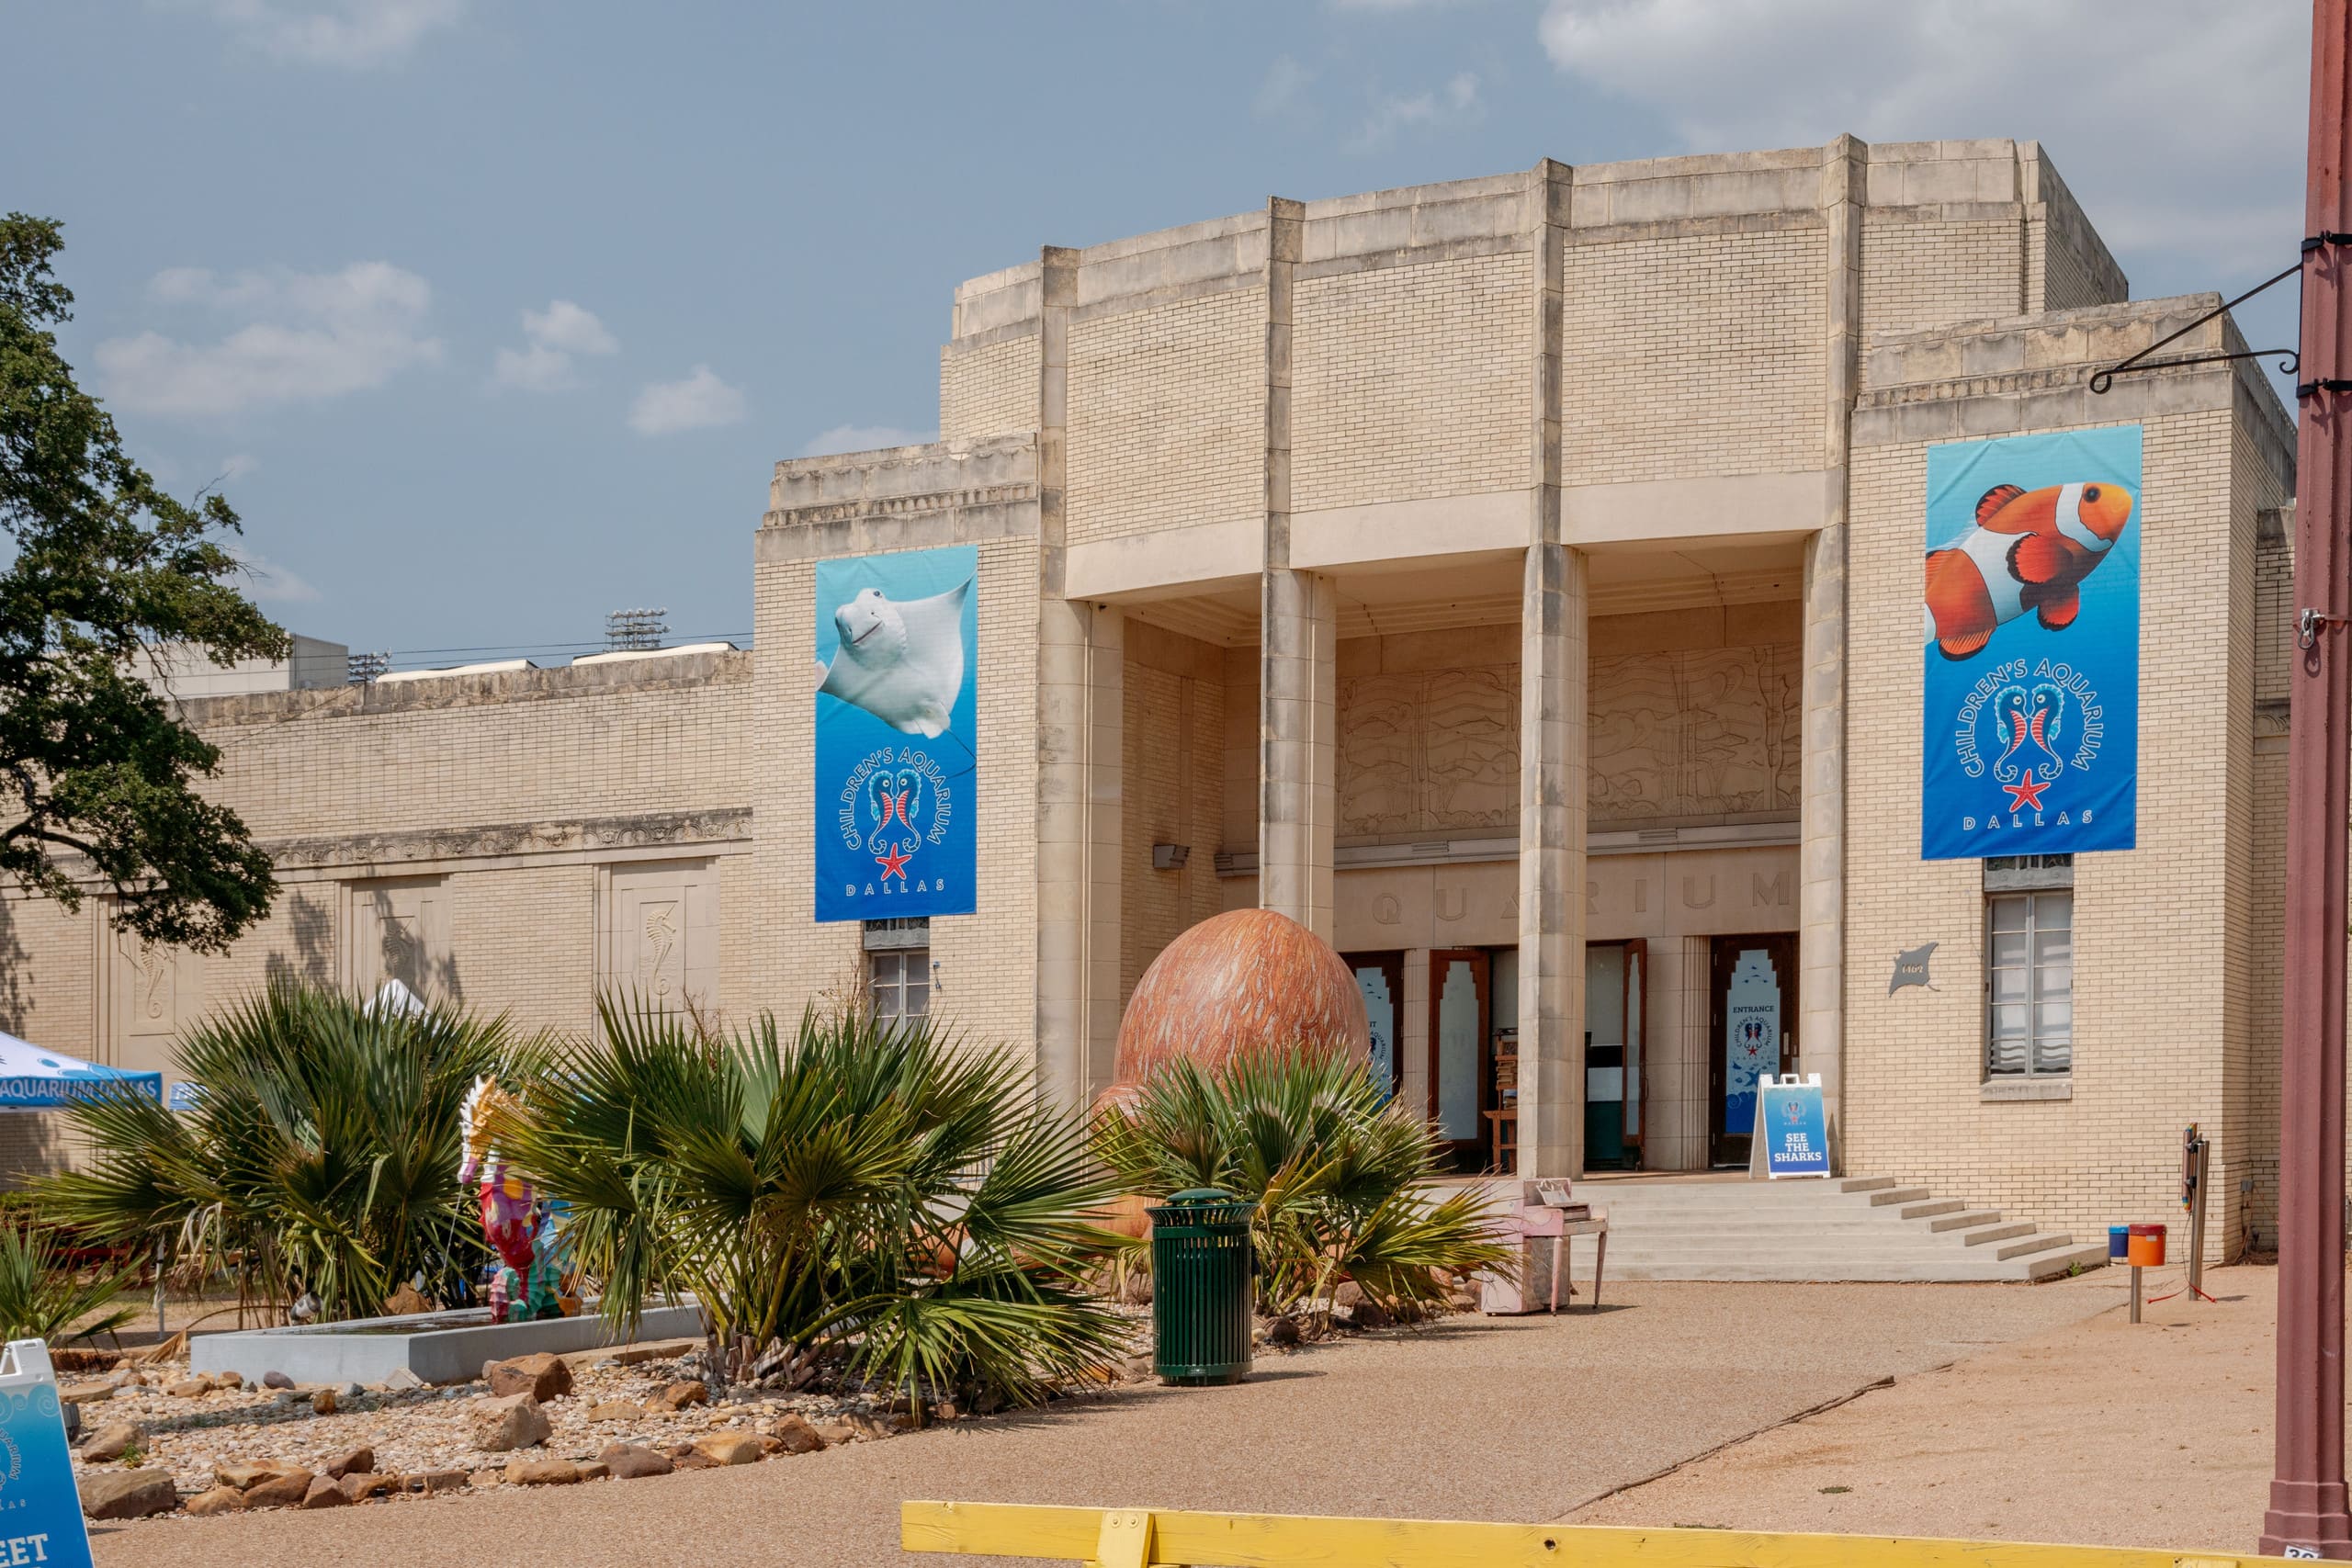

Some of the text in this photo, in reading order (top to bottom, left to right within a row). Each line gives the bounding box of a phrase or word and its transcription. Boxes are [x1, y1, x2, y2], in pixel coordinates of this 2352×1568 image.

[1956, 658, 2104, 778] CHILDREN'S AQUARIUM
[839, 746, 952, 851] CHILDREN'S AQUARIUM
[1963, 810, 2093, 830] DALLAS
[846, 878, 944, 897] DALLAS
[1733, 1005, 1774, 1014] ENTRANCE
[1755, 1016, 1773, 1046] AQUARIUM
[0, 1079, 95, 1101] AQUARIUM
[1785, 1133, 1807, 1143] SEE
[1785, 1143, 1810, 1152] THE
[1774, 1152, 1823, 1162] SHARKS
